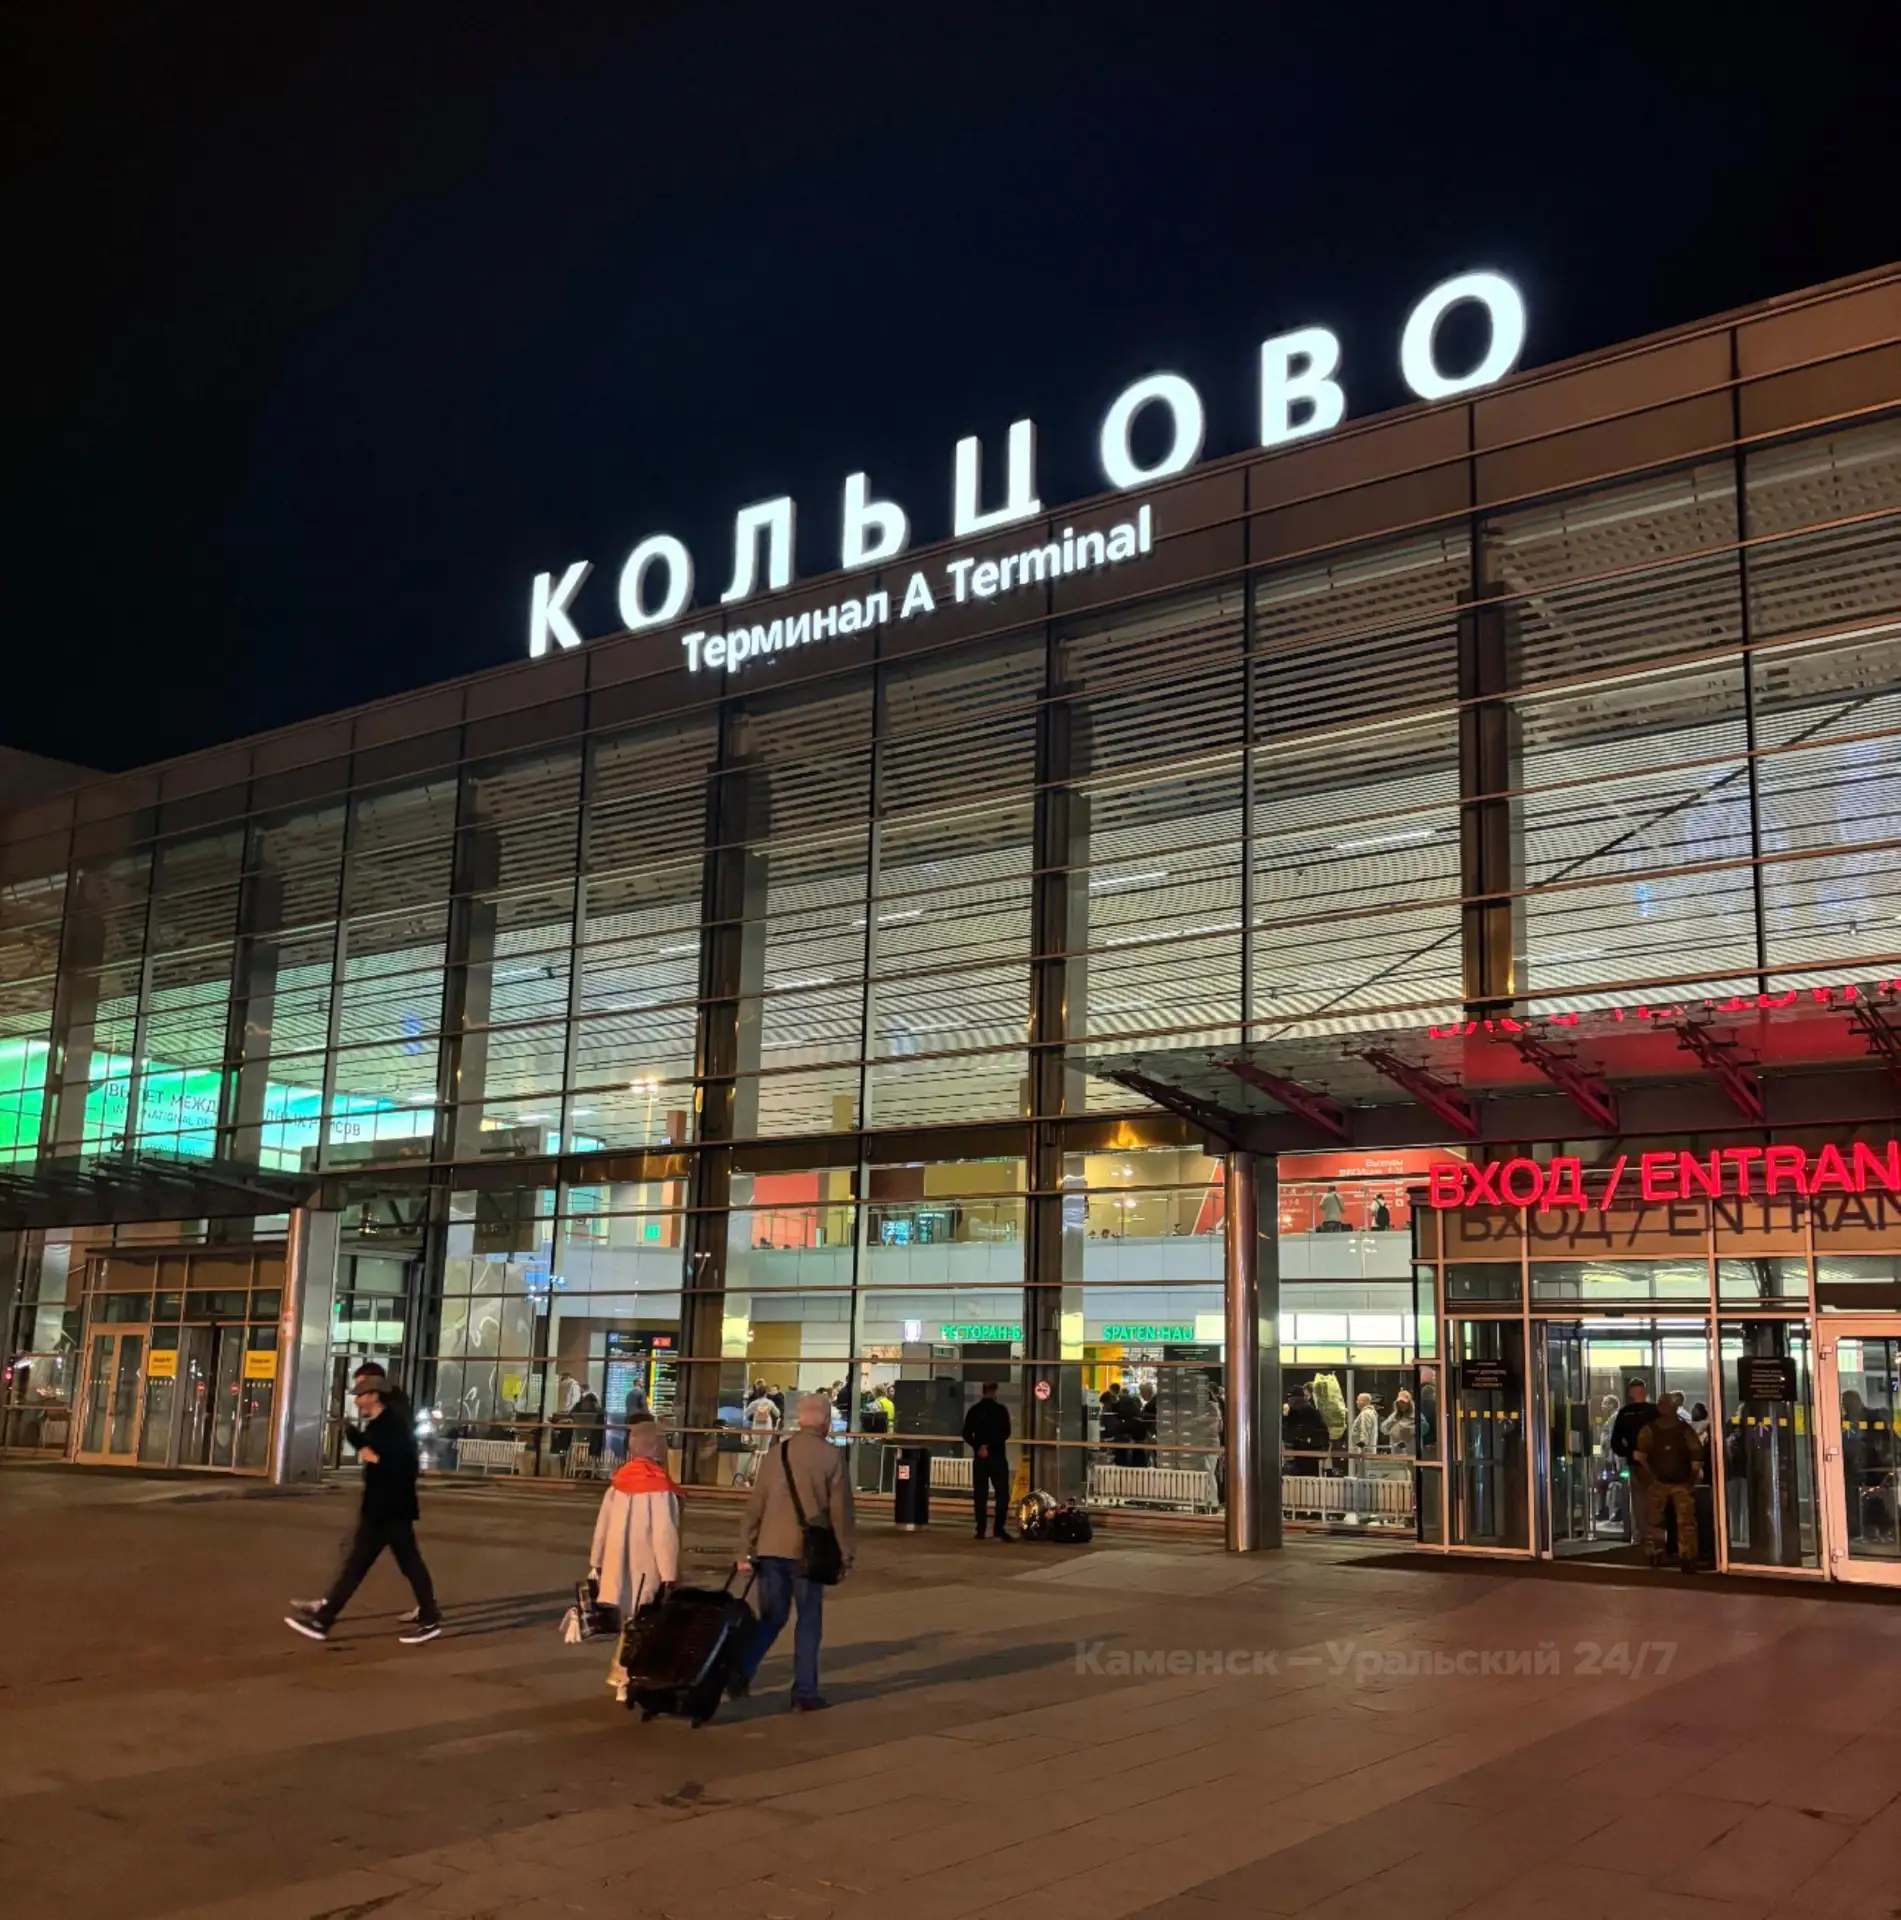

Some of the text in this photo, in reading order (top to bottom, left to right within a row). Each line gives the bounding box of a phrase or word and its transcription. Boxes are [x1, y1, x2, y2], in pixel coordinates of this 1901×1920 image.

[529, 271, 1526, 657] КОЛЬЦОВО
[681, 589, 889, 675] Терминал
[947, 504, 1153, 602] Terminal
[1429, 1139, 1901, 1214] ВХОД / ENTRAN
[1103, 1325, 1194, 1343] SPATEN-HAU
